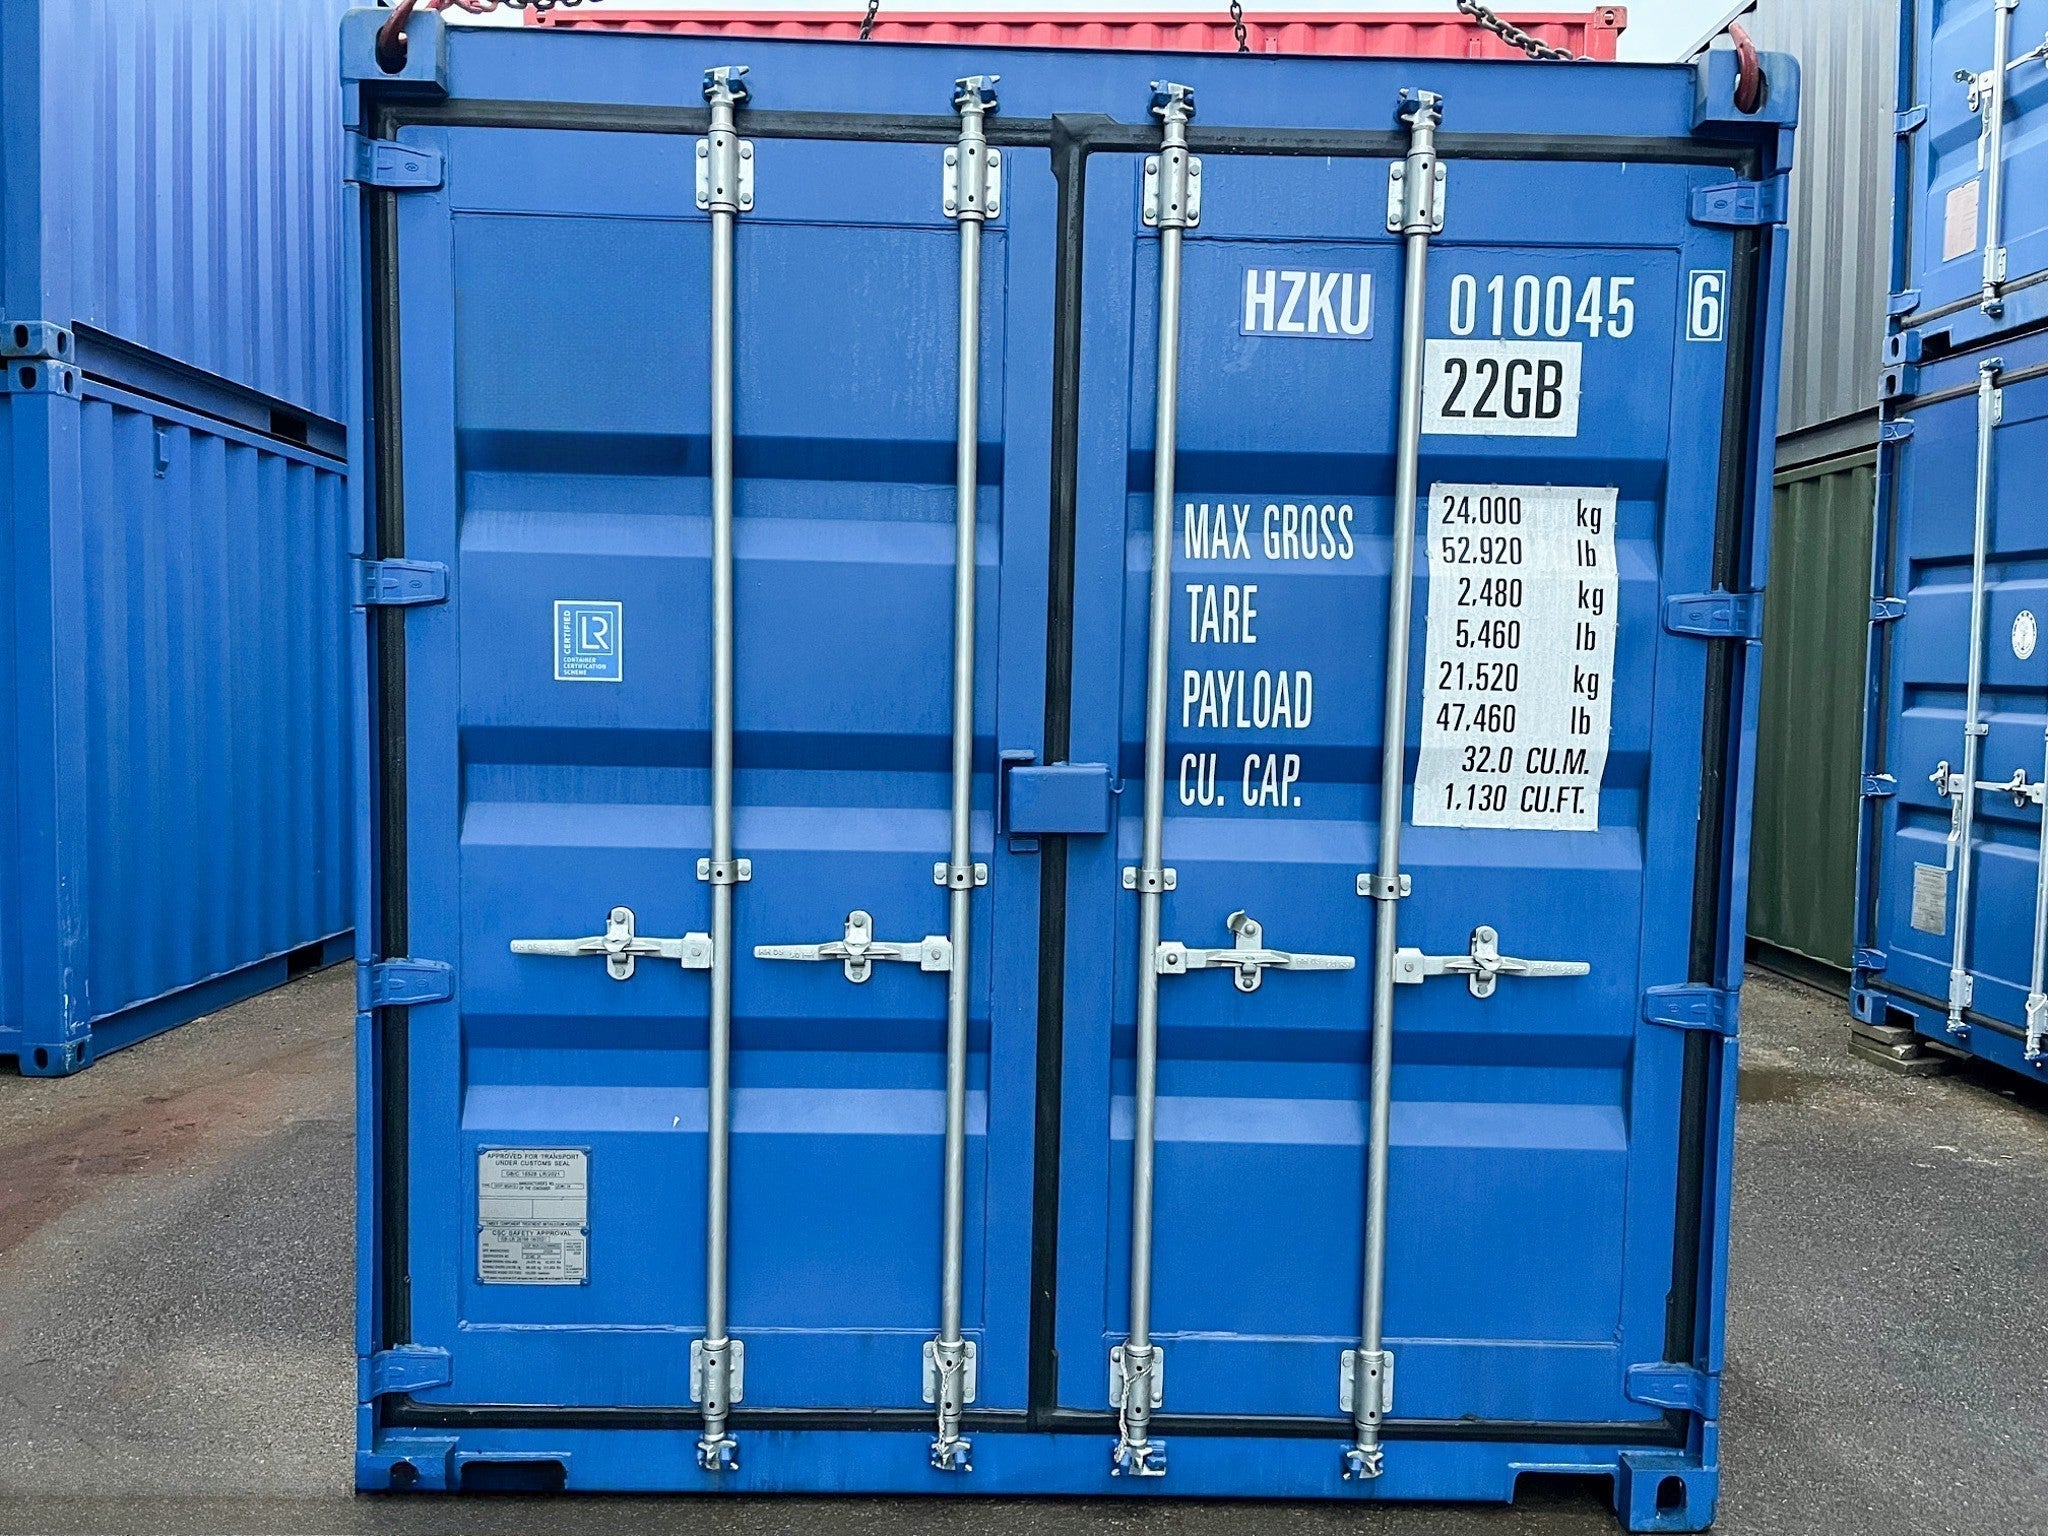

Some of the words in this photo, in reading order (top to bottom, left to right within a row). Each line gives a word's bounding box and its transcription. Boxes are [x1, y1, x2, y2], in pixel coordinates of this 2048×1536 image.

[1245, 269, 1371, 335] HZKU
[1449, 274, 1635, 338] 010045
[1693, 274, 1721, 339] 6
[1441, 357, 1563, 419] 22GB
[1185, 503, 1251, 560] MAX
[1263, 504, 1354, 560] GROSS
[1442, 495, 1522, 525] 24,000
[1577, 498, 1602, 535] kg
[1442, 536, 1522, 565] 52,920
[1577, 539, 1597, 567] lb
[1186, 584, 1258, 644] TARE
[1457, 577, 1522, 608] 2,480
[1578, 579, 1604, 616] kg
[563, 610, 571, 655] CERTIFIED
[581, 616, 610, 650] LR
[1456, 619, 1521, 649] 5,460
[1576, 622, 1596, 651] lb
[1183, 670, 1312, 729] PAYLOAD
[1438, 661, 1519, 692] 21,520
[1573, 664, 1599, 701] kg
[1436, 702, 1516, 733] 47,460
[1571, 705, 1591, 735] lb
[1180, 753, 1224, 806] CU.
[1242, 753, 1301, 807] CAP.
[1461, 745, 1513, 774] 32.0
[1526, 747, 1590, 775] CU.M.
[1445, 782, 1507, 812] 1,130
[1520, 785, 1585, 814] CU.FT.
